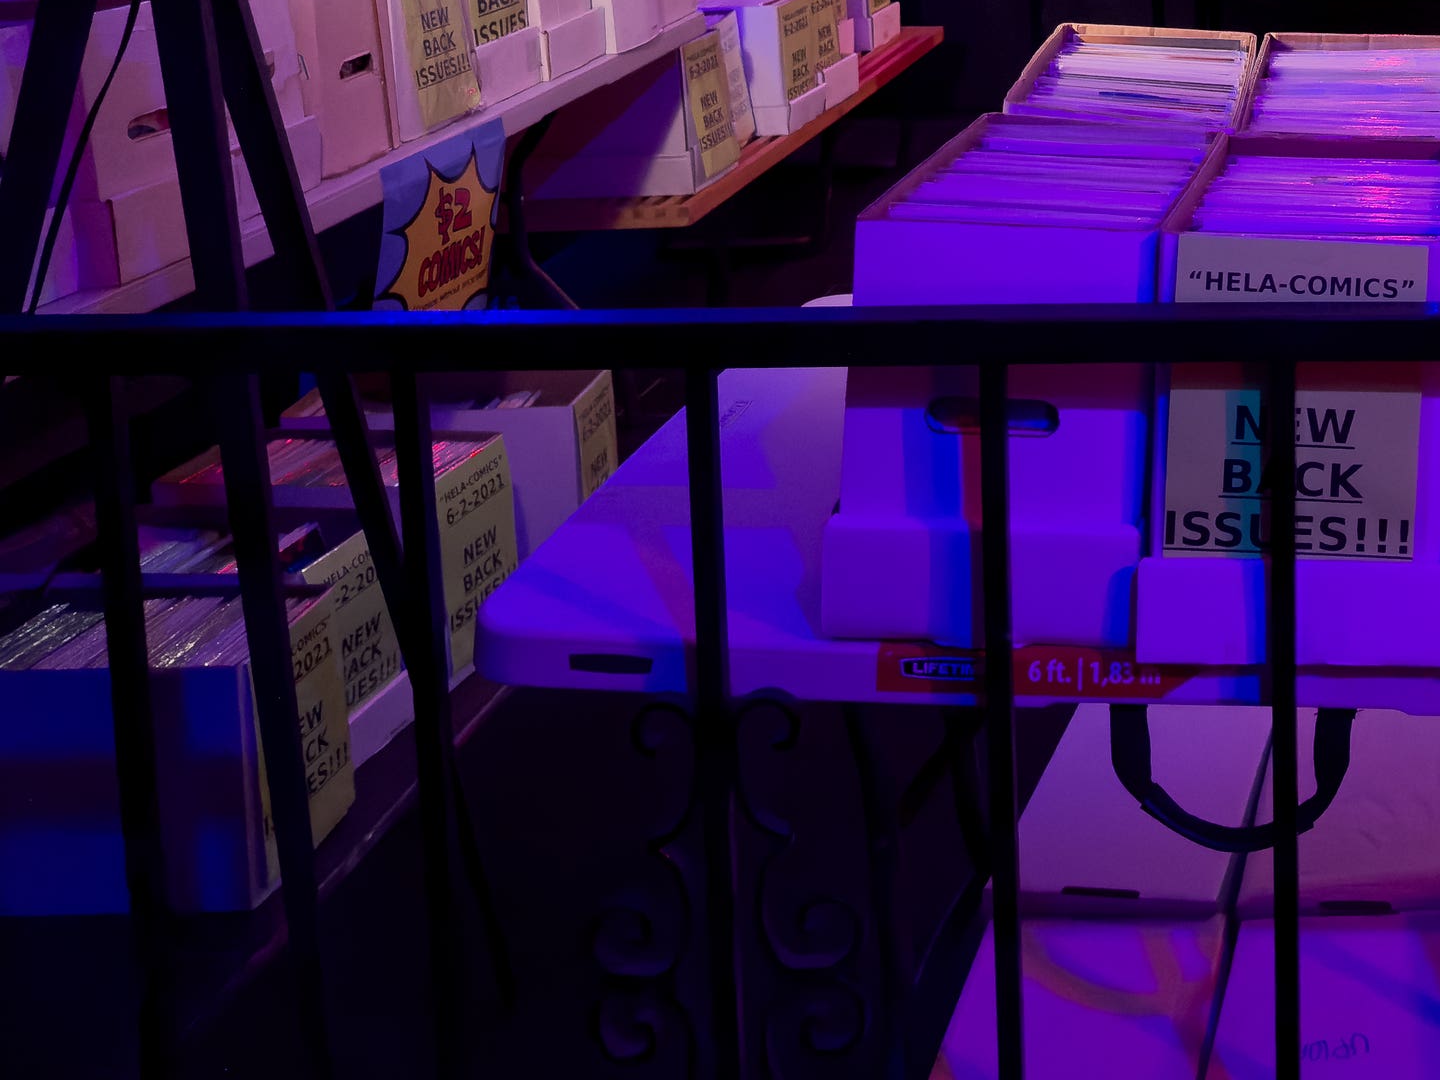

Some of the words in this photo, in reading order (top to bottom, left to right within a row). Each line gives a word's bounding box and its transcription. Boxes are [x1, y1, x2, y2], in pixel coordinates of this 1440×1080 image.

[421, 6, 450, 31] NEW
[423, 31, 457, 58] BACK
[416, 53, 471, 89] ISSUES!!!
[435, 186, 473, 246] $2
[418, 224, 486, 298] COMICS!
[1188, 270, 1415, 299] “HELA-COMICS”
[1235, 405, 1356, 445] NW
[1222, 457, 1365, 500] BCK
[446, 473, 505, 525] 6-2-2021
[463, 525, 497, 565] NEW
[463, 549, 503, 593] BACK
[341, 612, 382, 656] NEW
[343, 636, 382, 680] ACK
[1028, 660, 1041, 683] 6
[1047, 660, 1071, 683] ft.
[299, 700, 323, 732] EW
[305, 727, 329, 764] CK
